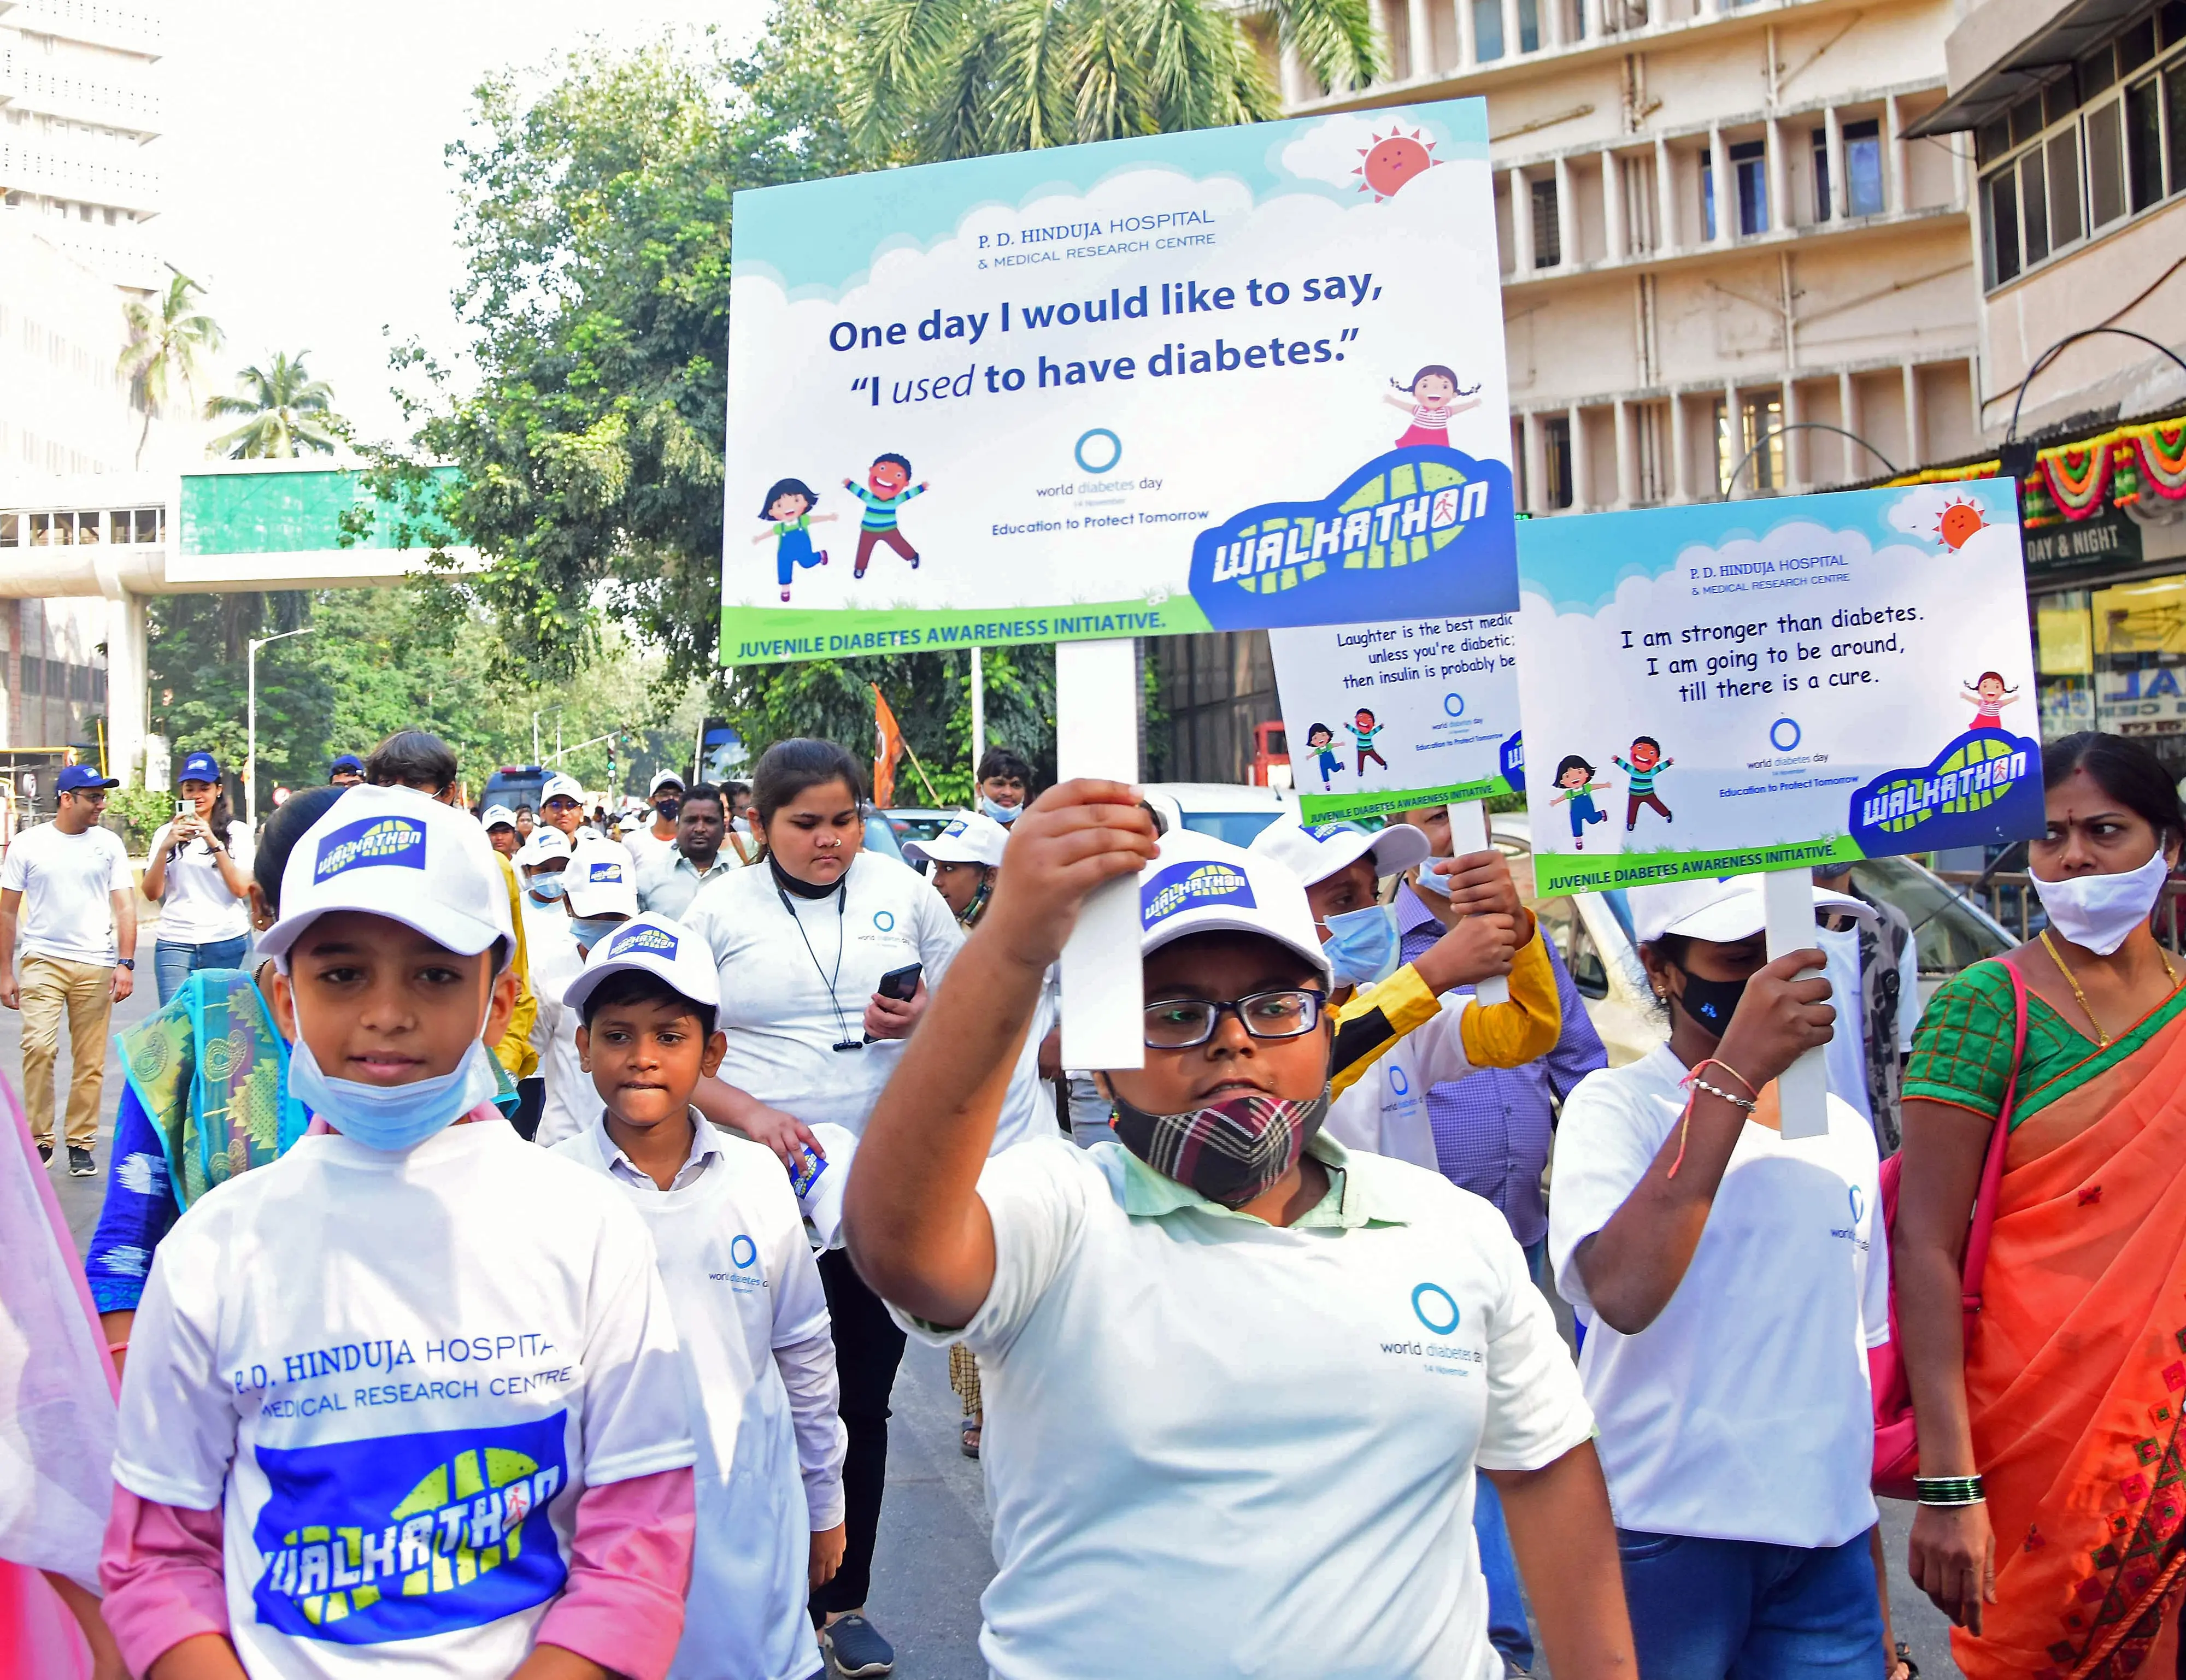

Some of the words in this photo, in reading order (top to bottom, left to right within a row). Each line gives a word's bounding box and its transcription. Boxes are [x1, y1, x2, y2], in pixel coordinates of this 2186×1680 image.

[978, 235, 991, 249] P.
[996, 232, 1015, 246] D.
[1021, 222, 1102, 244] HINDUJA
[1110, 209, 1215, 233] HOSPITAL
[977, 258, 988, 270] &
[995, 250, 1060, 269] MEDICAL
[1066, 240, 1149, 260] RESEARCH
[1156, 234, 1216, 250] CENTRE
[829, 321, 907, 352] One
[918, 309, 990, 345] day
[1001, 302, 1010, 332] I
[1022, 286, 1147, 329] would
[1162, 280, 1235, 315] like
[1246, 278, 1290, 306] to
[1302, 273, 1383, 307] say,
[892, 363, 976, 404] used
[984, 364, 1026, 394] to
[1038, 356, 1135, 388] have
[1037, 484, 1073, 497] world
[1078, 479, 1135, 495] diabetes
[1139, 477, 1163, 491] day
[991, 520, 1061, 537] Education
[1066, 519, 1079, 529] to
[1084, 514, 1135, 528] Protect
[1138, 510, 1209, 523] Tomorrow
[1212, 480, 1489, 583] WALKATHON
[2027, 537, 2052, 563] DAY
[2058, 535, 2070, 558] &
[2073, 525, 2118, 555] NIGHT
[1690, 568, 1699, 579] P.
[1703, 567, 1716, 578] D.
[1719, 562, 1775, 576] HINDUJA
[1779, 555, 1849, 571] HOSPITAL
[1691, 587, 1699, 596] &
[1703, 583, 1748, 594] MEDICAL
[1752, 577, 1807, 590] RESEARCH
[1811, 573, 1850, 585] CENTRE
[737, 636, 825, 658] JUVENILE
[830, 629, 921, 652] DIABETES
[926, 620, 1049, 644] AWARENESS
[1053, 611, 1166, 634] INITIATIVE.
[1337, 629, 1397, 648] Laughter
[1403, 626, 1414, 638] is
[1420, 621, 1441, 636] the
[1446, 618, 1474, 634] best
[1621, 630, 1633, 649] I
[1643, 629, 1672, 647] am
[1681, 621, 1767, 644] stronger
[1777, 614, 1822, 634] than
[1832, 605, 1924, 627] diabetes.
[1368, 648, 1408, 664] unless
[1413, 641, 1456, 662] you're
[1647, 657, 1659, 676] I
[1668, 658, 1697, 675] am
[1707, 649, 1758, 678] going
[1767, 647, 1788, 663] to
[1797, 642, 1820, 662] be
[1831, 633, 1905, 657] around,
[1343, 674, 1374, 689] then
[1379, 666, 1420, 685] insulin
[1425, 664, 1436, 677] is
[1441, 656, 1495, 680] probably
[1679, 681, 1706, 702] till
[1716, 676, 1773, 699] there
[1783, 674, 1797, 692] is
[1808, 676, 1819, 688] a
[1829, 670, 1879, 686] cure.
[1747, 758, 1772, 769] world
[1774, 755, 1811, 767] diabetes
[1813, 753, 1829, 763] day
[1719, 786, 1766, 798] Education
[1768, 784, 1777, 792] to
[1780, 780, 1812, 791] Protect
[1814, 775, 1859, 787] Tomorrow
[1862, 751, 2026, 827] WALKATHON
[1311, 808, 1352, 823] JUVENILE
[1354, 800, 1395, 816] DIABETES
[1397, 792, 1449, 808] AWARENESS
[318, 831, 421, 875] WALKATHON
[1548, 871, 1611, 891] JUVENILE
[1614, 863, 1678, 883] DIABETES
[1681, 853, 1762, 875] AWARENESS
[1766, 844, 1837, 864] INITIATIVE.
[1145, 875, 1245, 919] WALKATHON
[284, 1340, 415, 1382] HINDUJA
[1380, 1340, 1421, 1355] world
[1426, 1343, 1471, 1361] diabetes
[355, 1380, 479, 1408] RESEARCH
[489, 1366, 572, 1396] CENTRE
